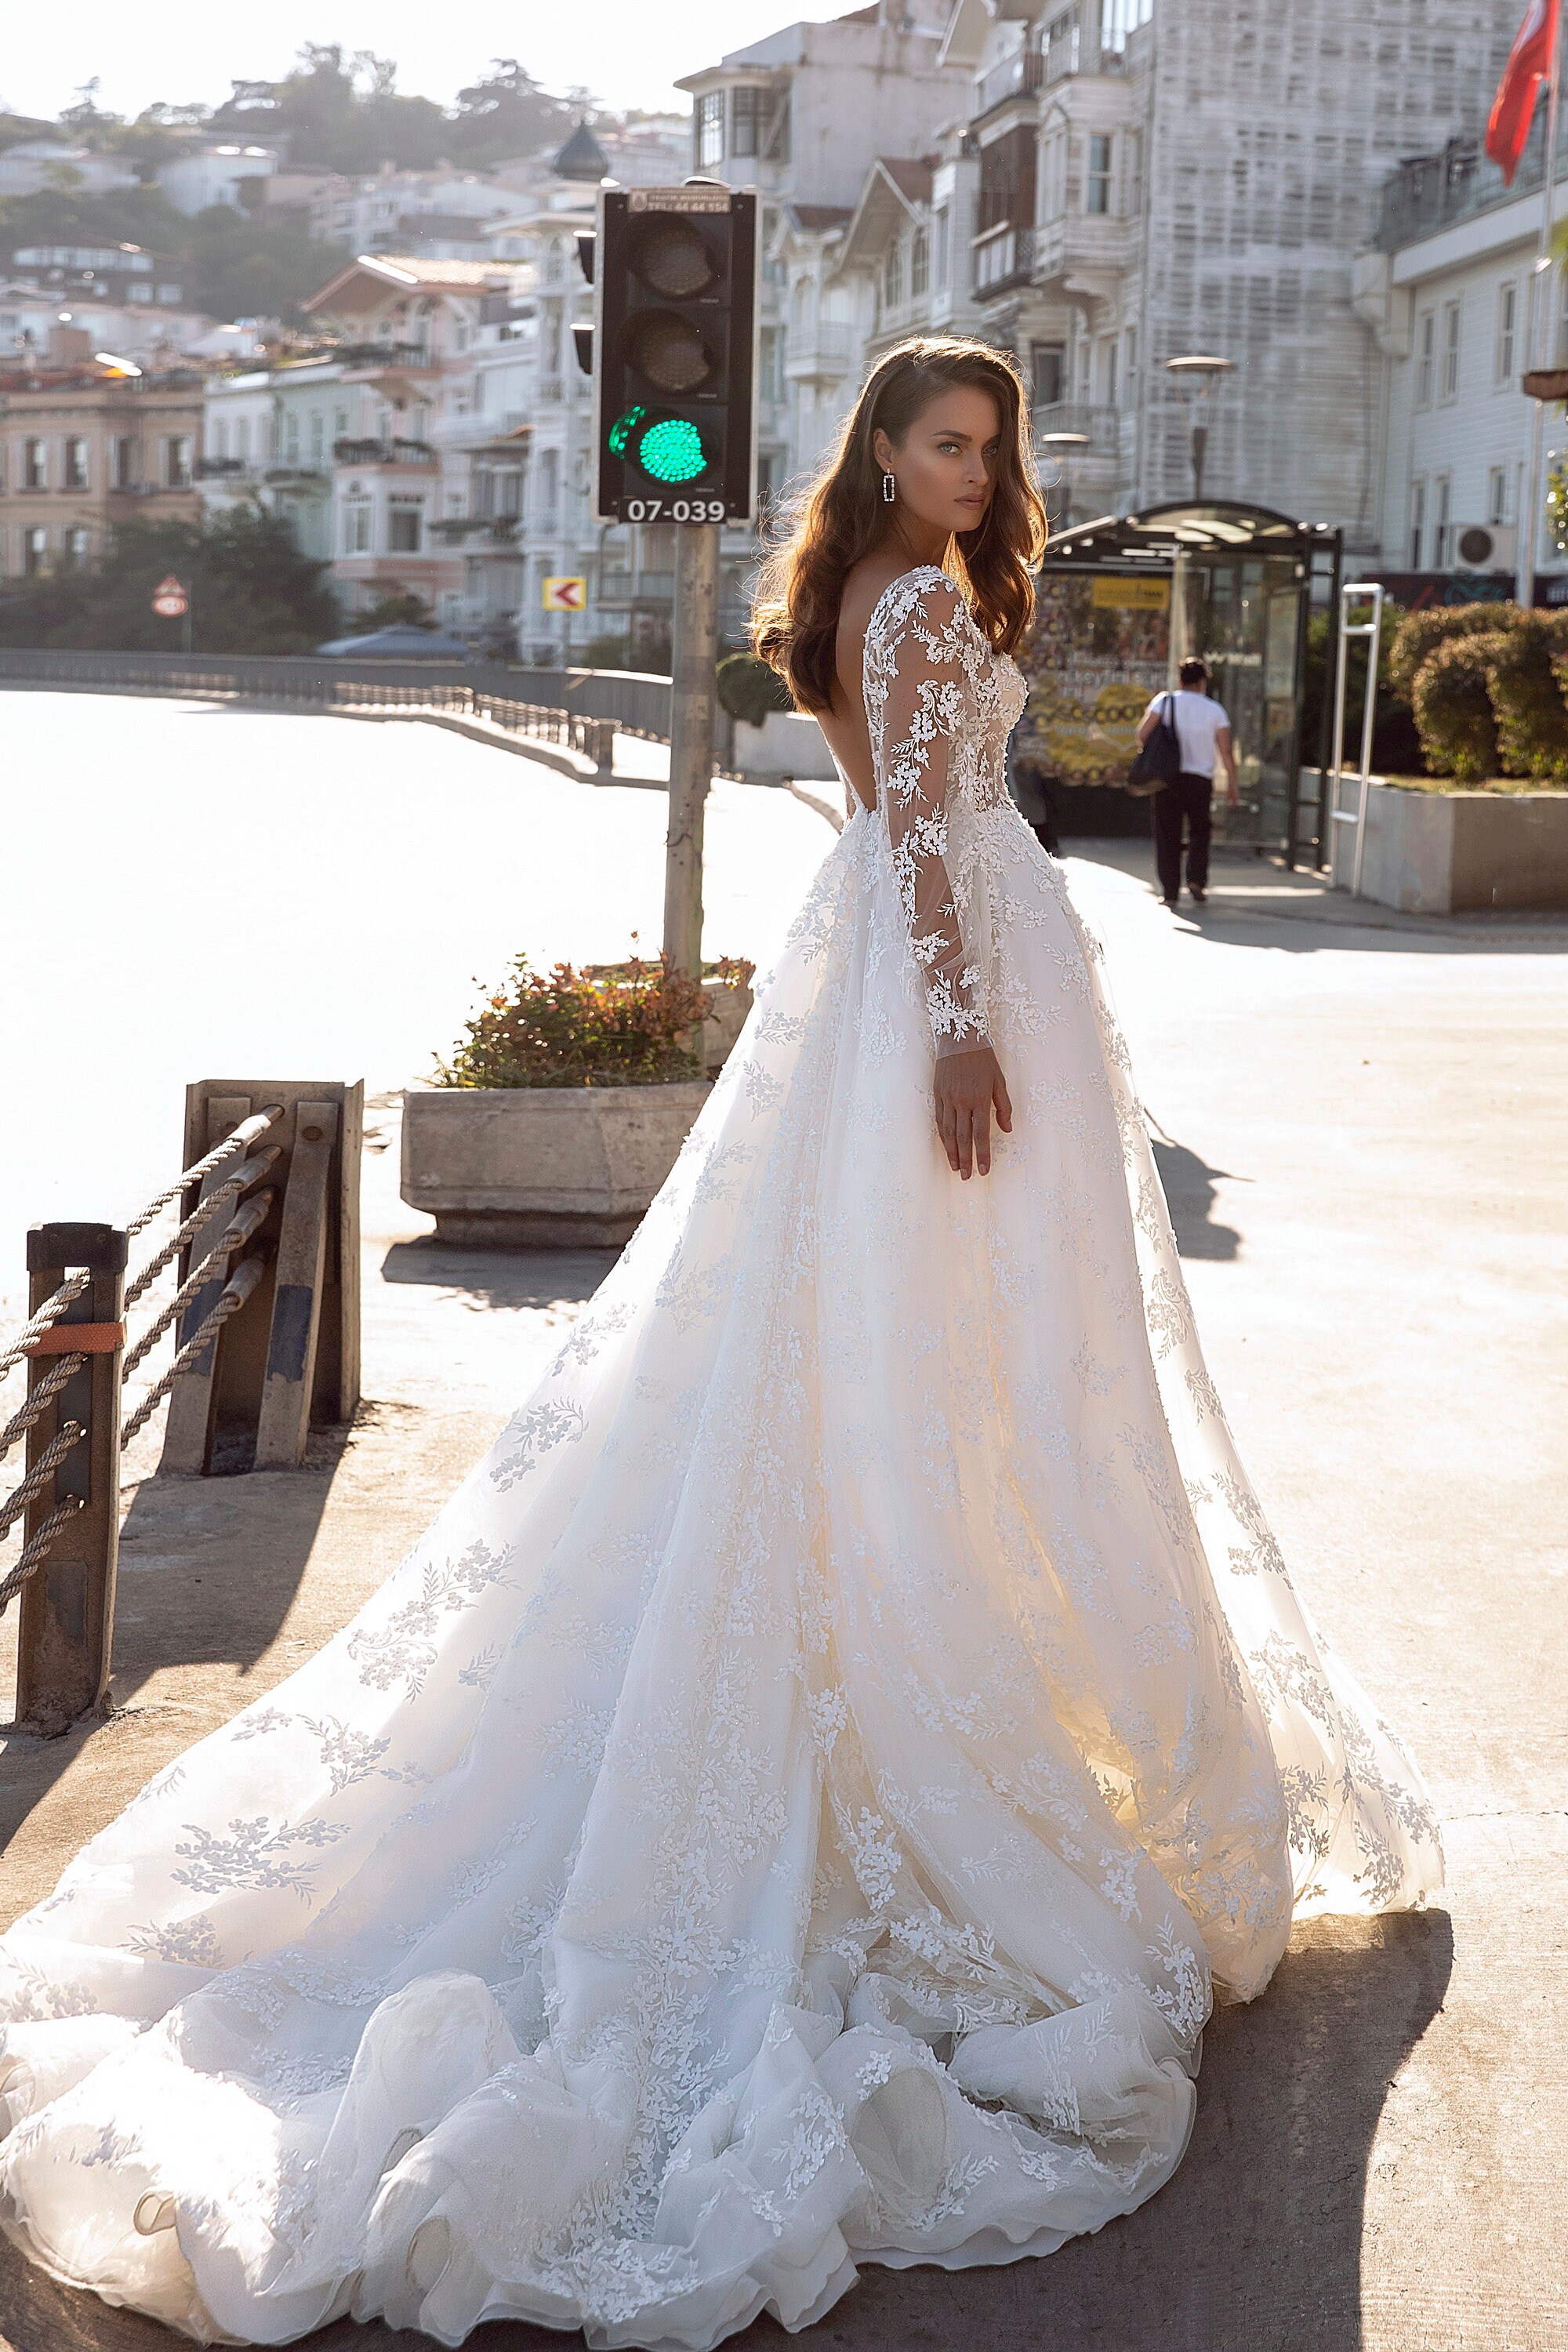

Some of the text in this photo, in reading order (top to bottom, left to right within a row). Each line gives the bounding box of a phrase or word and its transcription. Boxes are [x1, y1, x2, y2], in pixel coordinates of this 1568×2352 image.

[675, 201, 689, 212] 44
[691, 202, 706, 212] 44
[627, 499, 725, 522] 07-039
